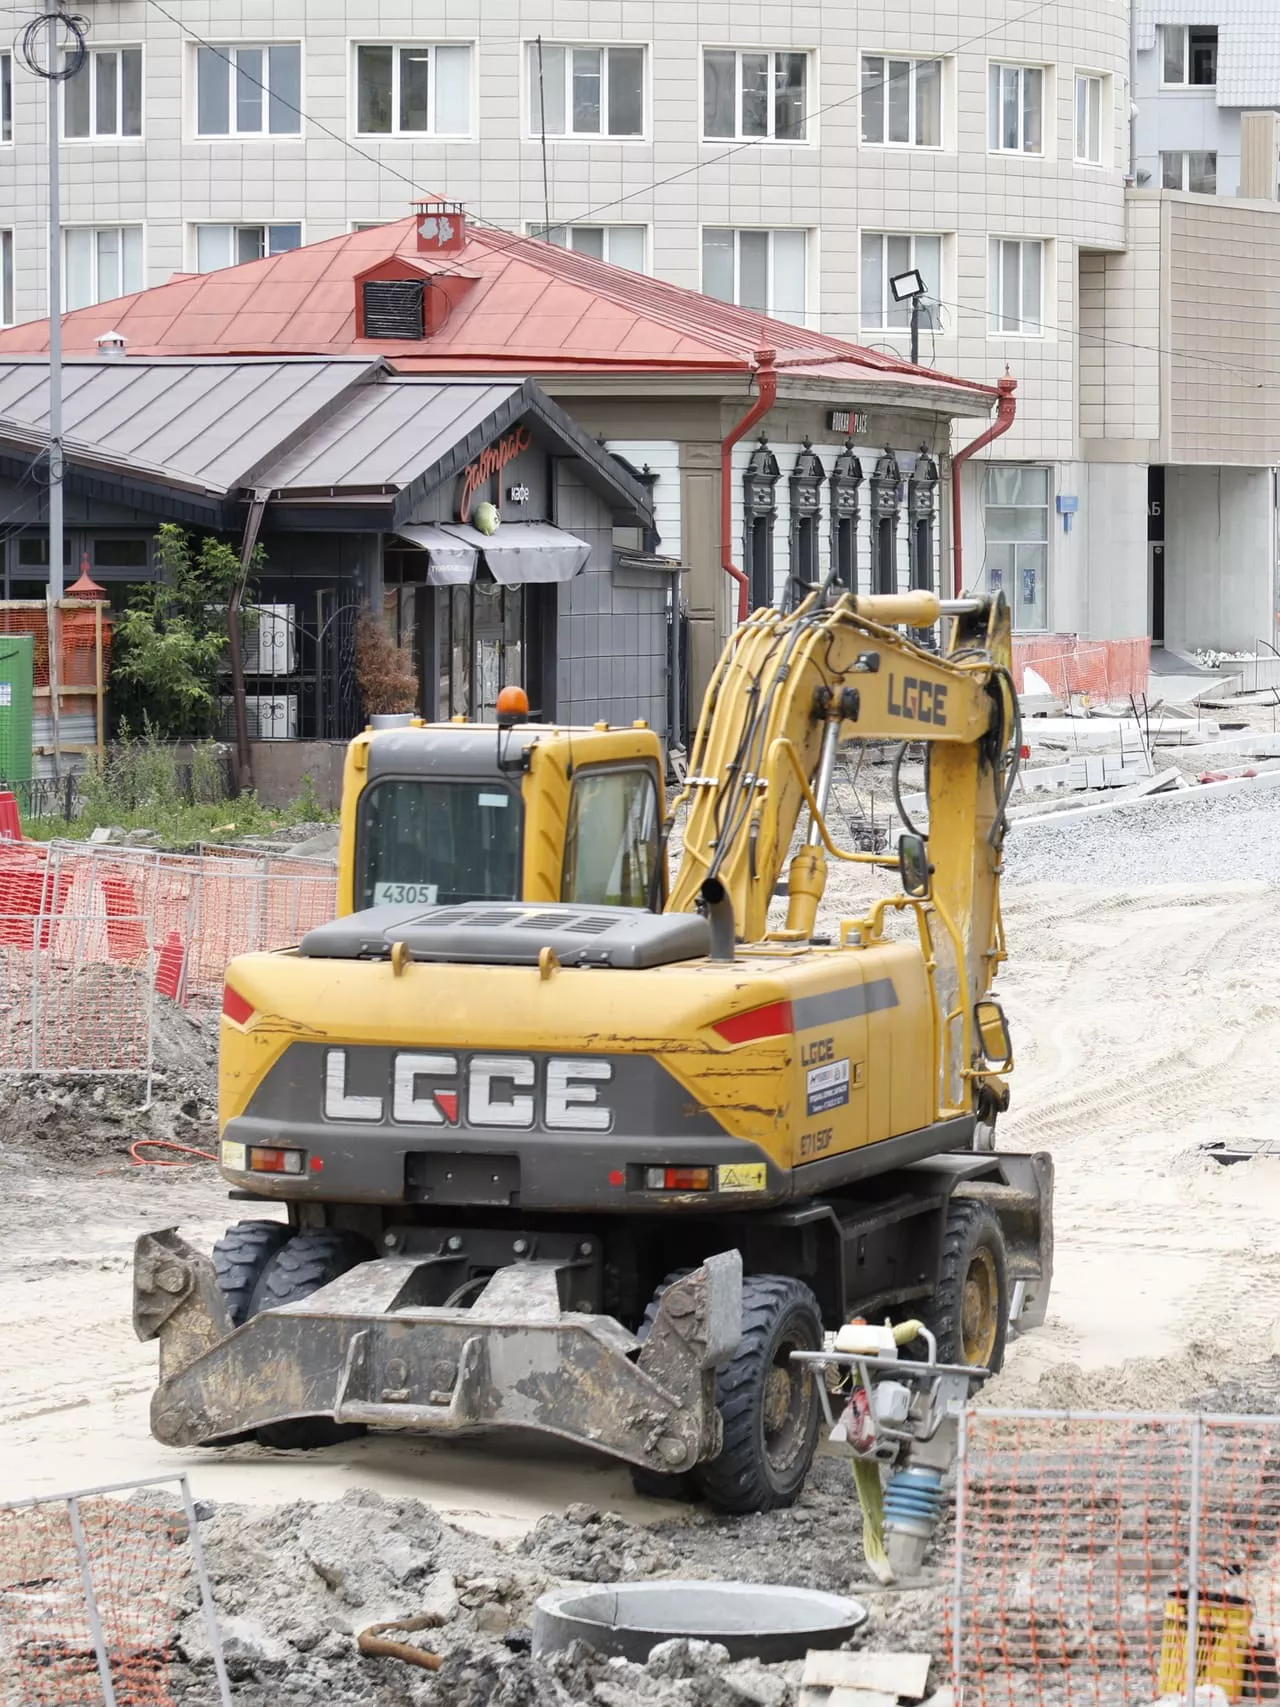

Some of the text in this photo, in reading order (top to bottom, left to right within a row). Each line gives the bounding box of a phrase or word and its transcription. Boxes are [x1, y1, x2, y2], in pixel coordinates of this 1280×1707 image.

[888, 672, 948, 727] LGCE
[382, 885, 429, 904] 4305
[801, 1037, 834, 1067] LGCE
[325, 1051, 612, 1129] LGCE
